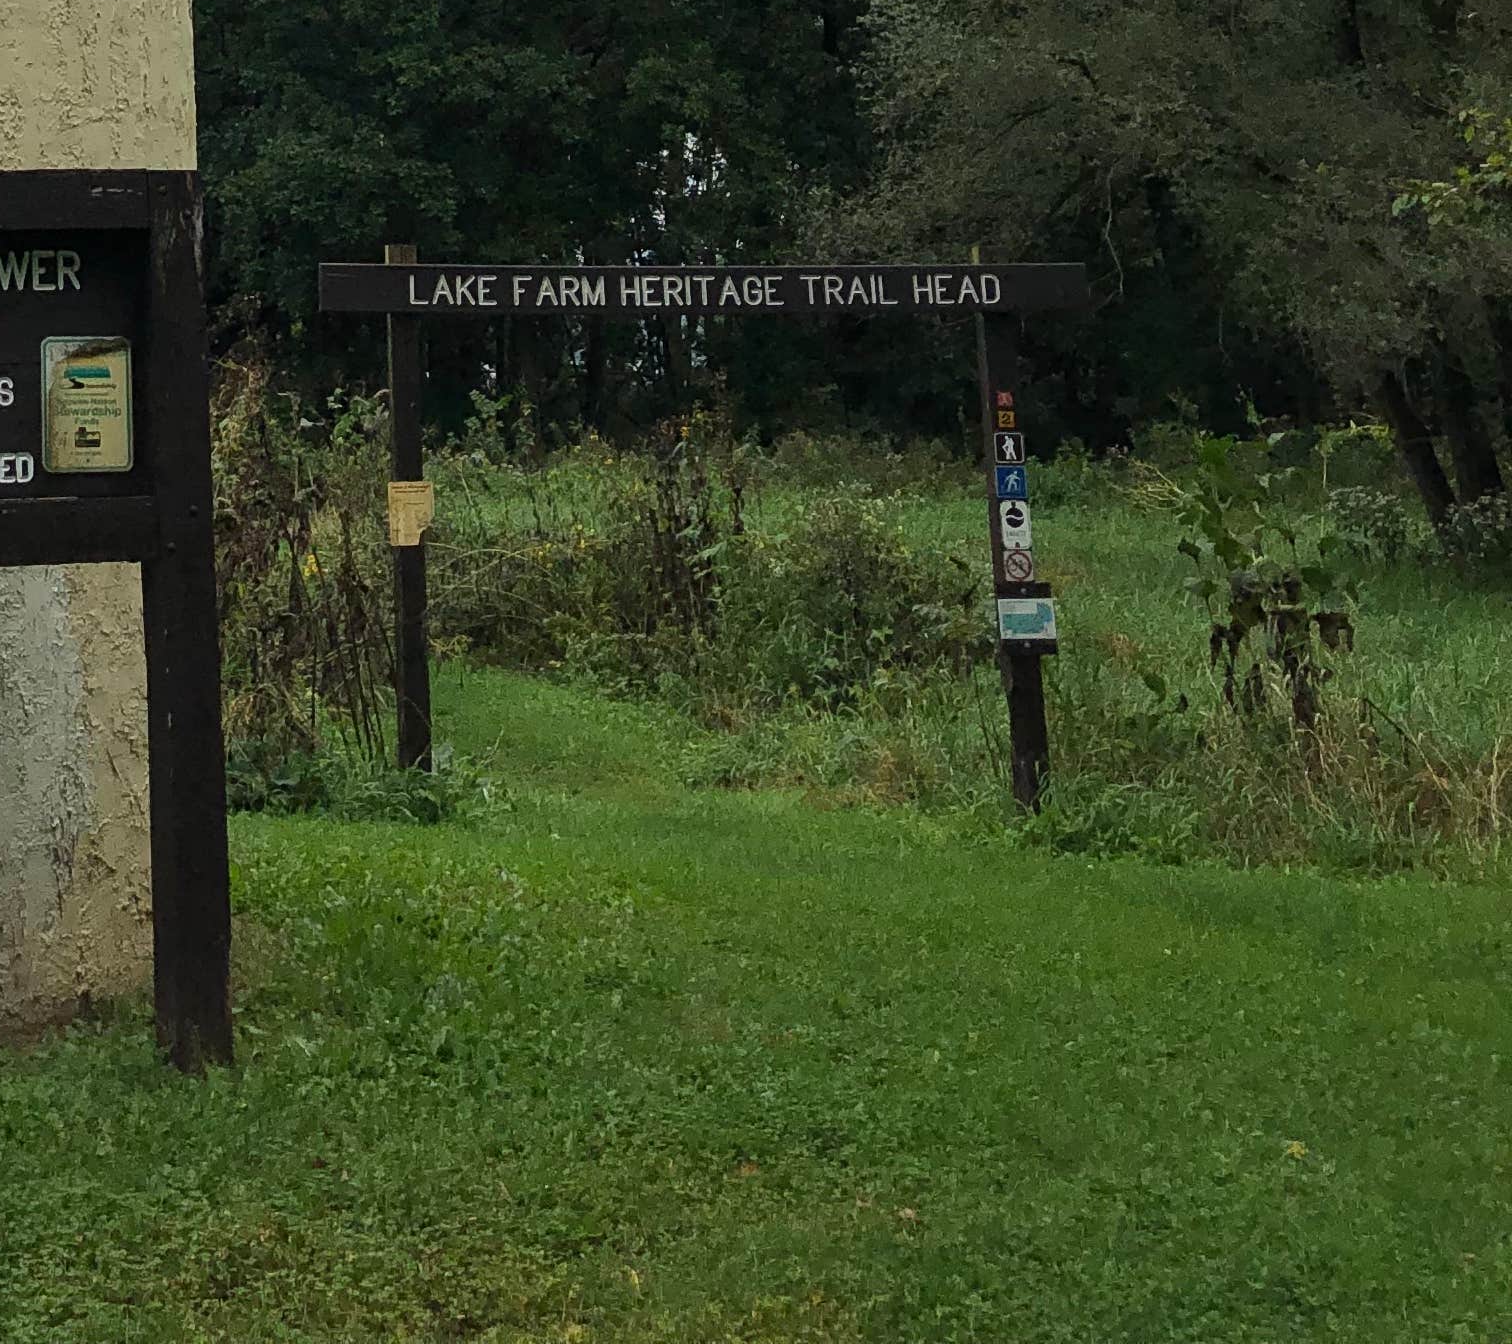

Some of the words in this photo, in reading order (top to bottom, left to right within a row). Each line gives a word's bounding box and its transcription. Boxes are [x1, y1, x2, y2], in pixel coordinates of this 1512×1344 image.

[409, 274, 498, 306] LAKE
[513, 275, 606, 306] FARM
[620, 275, 784, 306] HERITAGE
[799, 274, 899, 305] TRAIL
[912, 274, 1001, 305] HEAD
